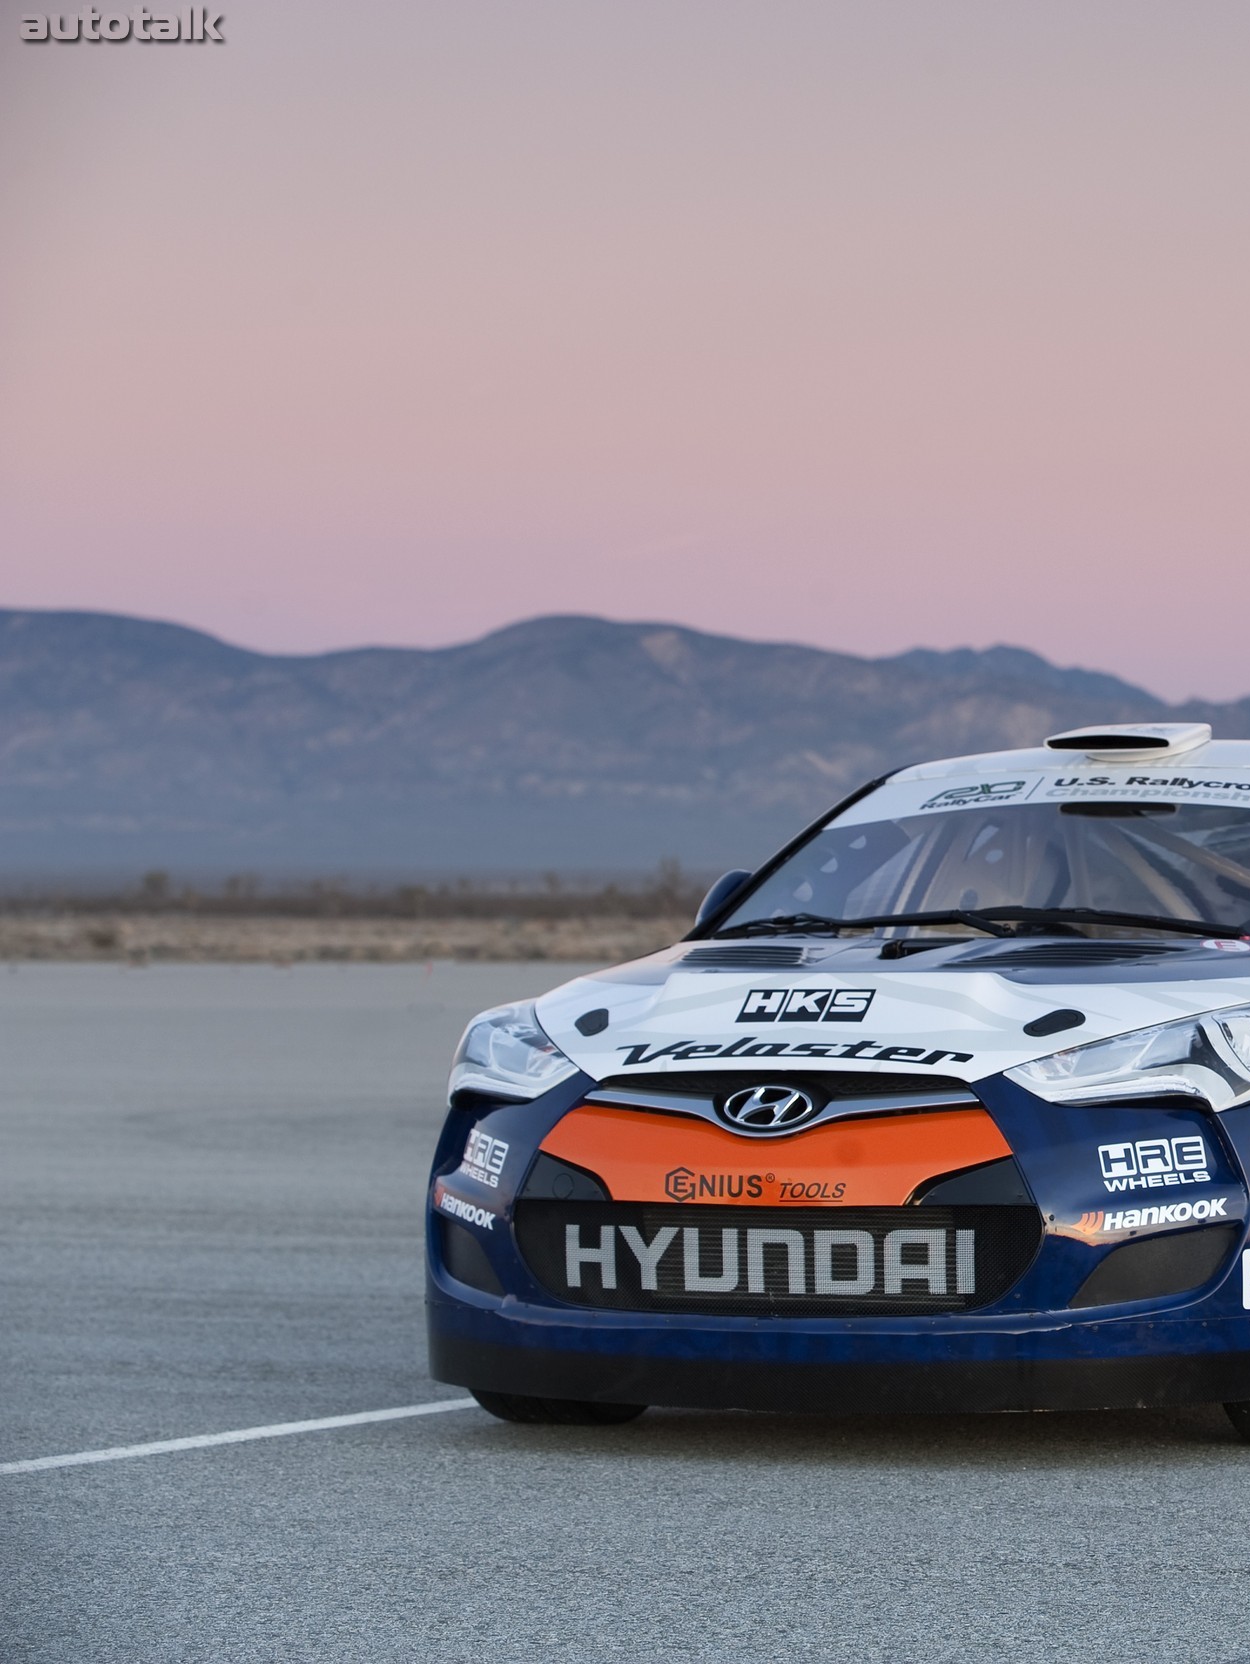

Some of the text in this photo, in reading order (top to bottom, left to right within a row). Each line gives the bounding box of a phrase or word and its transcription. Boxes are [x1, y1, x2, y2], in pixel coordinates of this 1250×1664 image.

[1054, 776, 1116, 787] U.S.
[919, 794, 1016, 810] RallyCar
[741, 989, 874, 1019] HKS
[616, 1036, 974, 1066] Veloster
[1098, 1135, 1207, 1178] HRE
[460, 1161, 499, 1188] WHEELS
[1104, 1170, 1211, 1192] WHEELS
[779, 1182, 847, 1199] TOOLS
[565, 1224, 976, 1295] HYUNDAI
